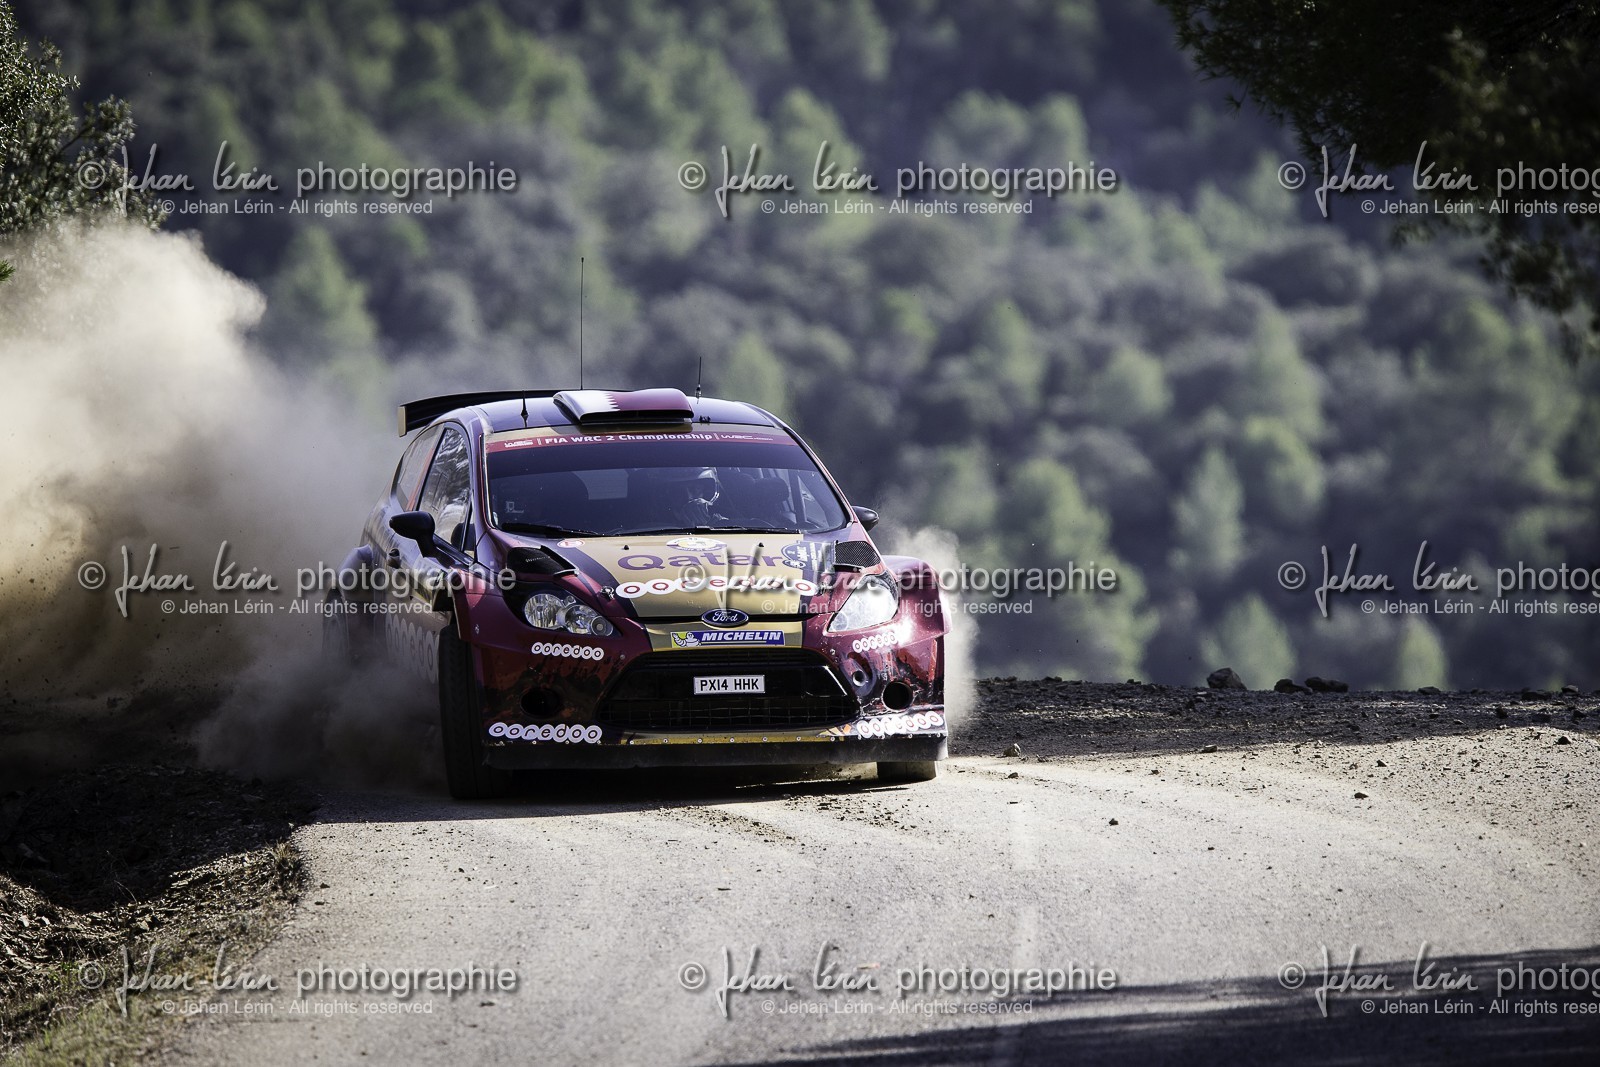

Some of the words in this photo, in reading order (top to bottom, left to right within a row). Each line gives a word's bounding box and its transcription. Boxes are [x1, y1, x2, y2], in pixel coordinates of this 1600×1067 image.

[545, 437, 567, 445] FIA
[571, 435, 602, 443] WRC
[618, 432, 713, 441] Championship
[617, 553, 783, 571] Qatar
[619, 575, 816, 598] ooreo
[712, 611, 738, 622] Ford
[701, 631, 781, 641] MICHELIN
[854, 633, 898, 652] ooredo
[532, 643, 604, 660] ooredoo
[700, 679, 728, 691] PX14
[734, 678, 759, 690] HHK
[490, 723, 601, 742] ooredoo
